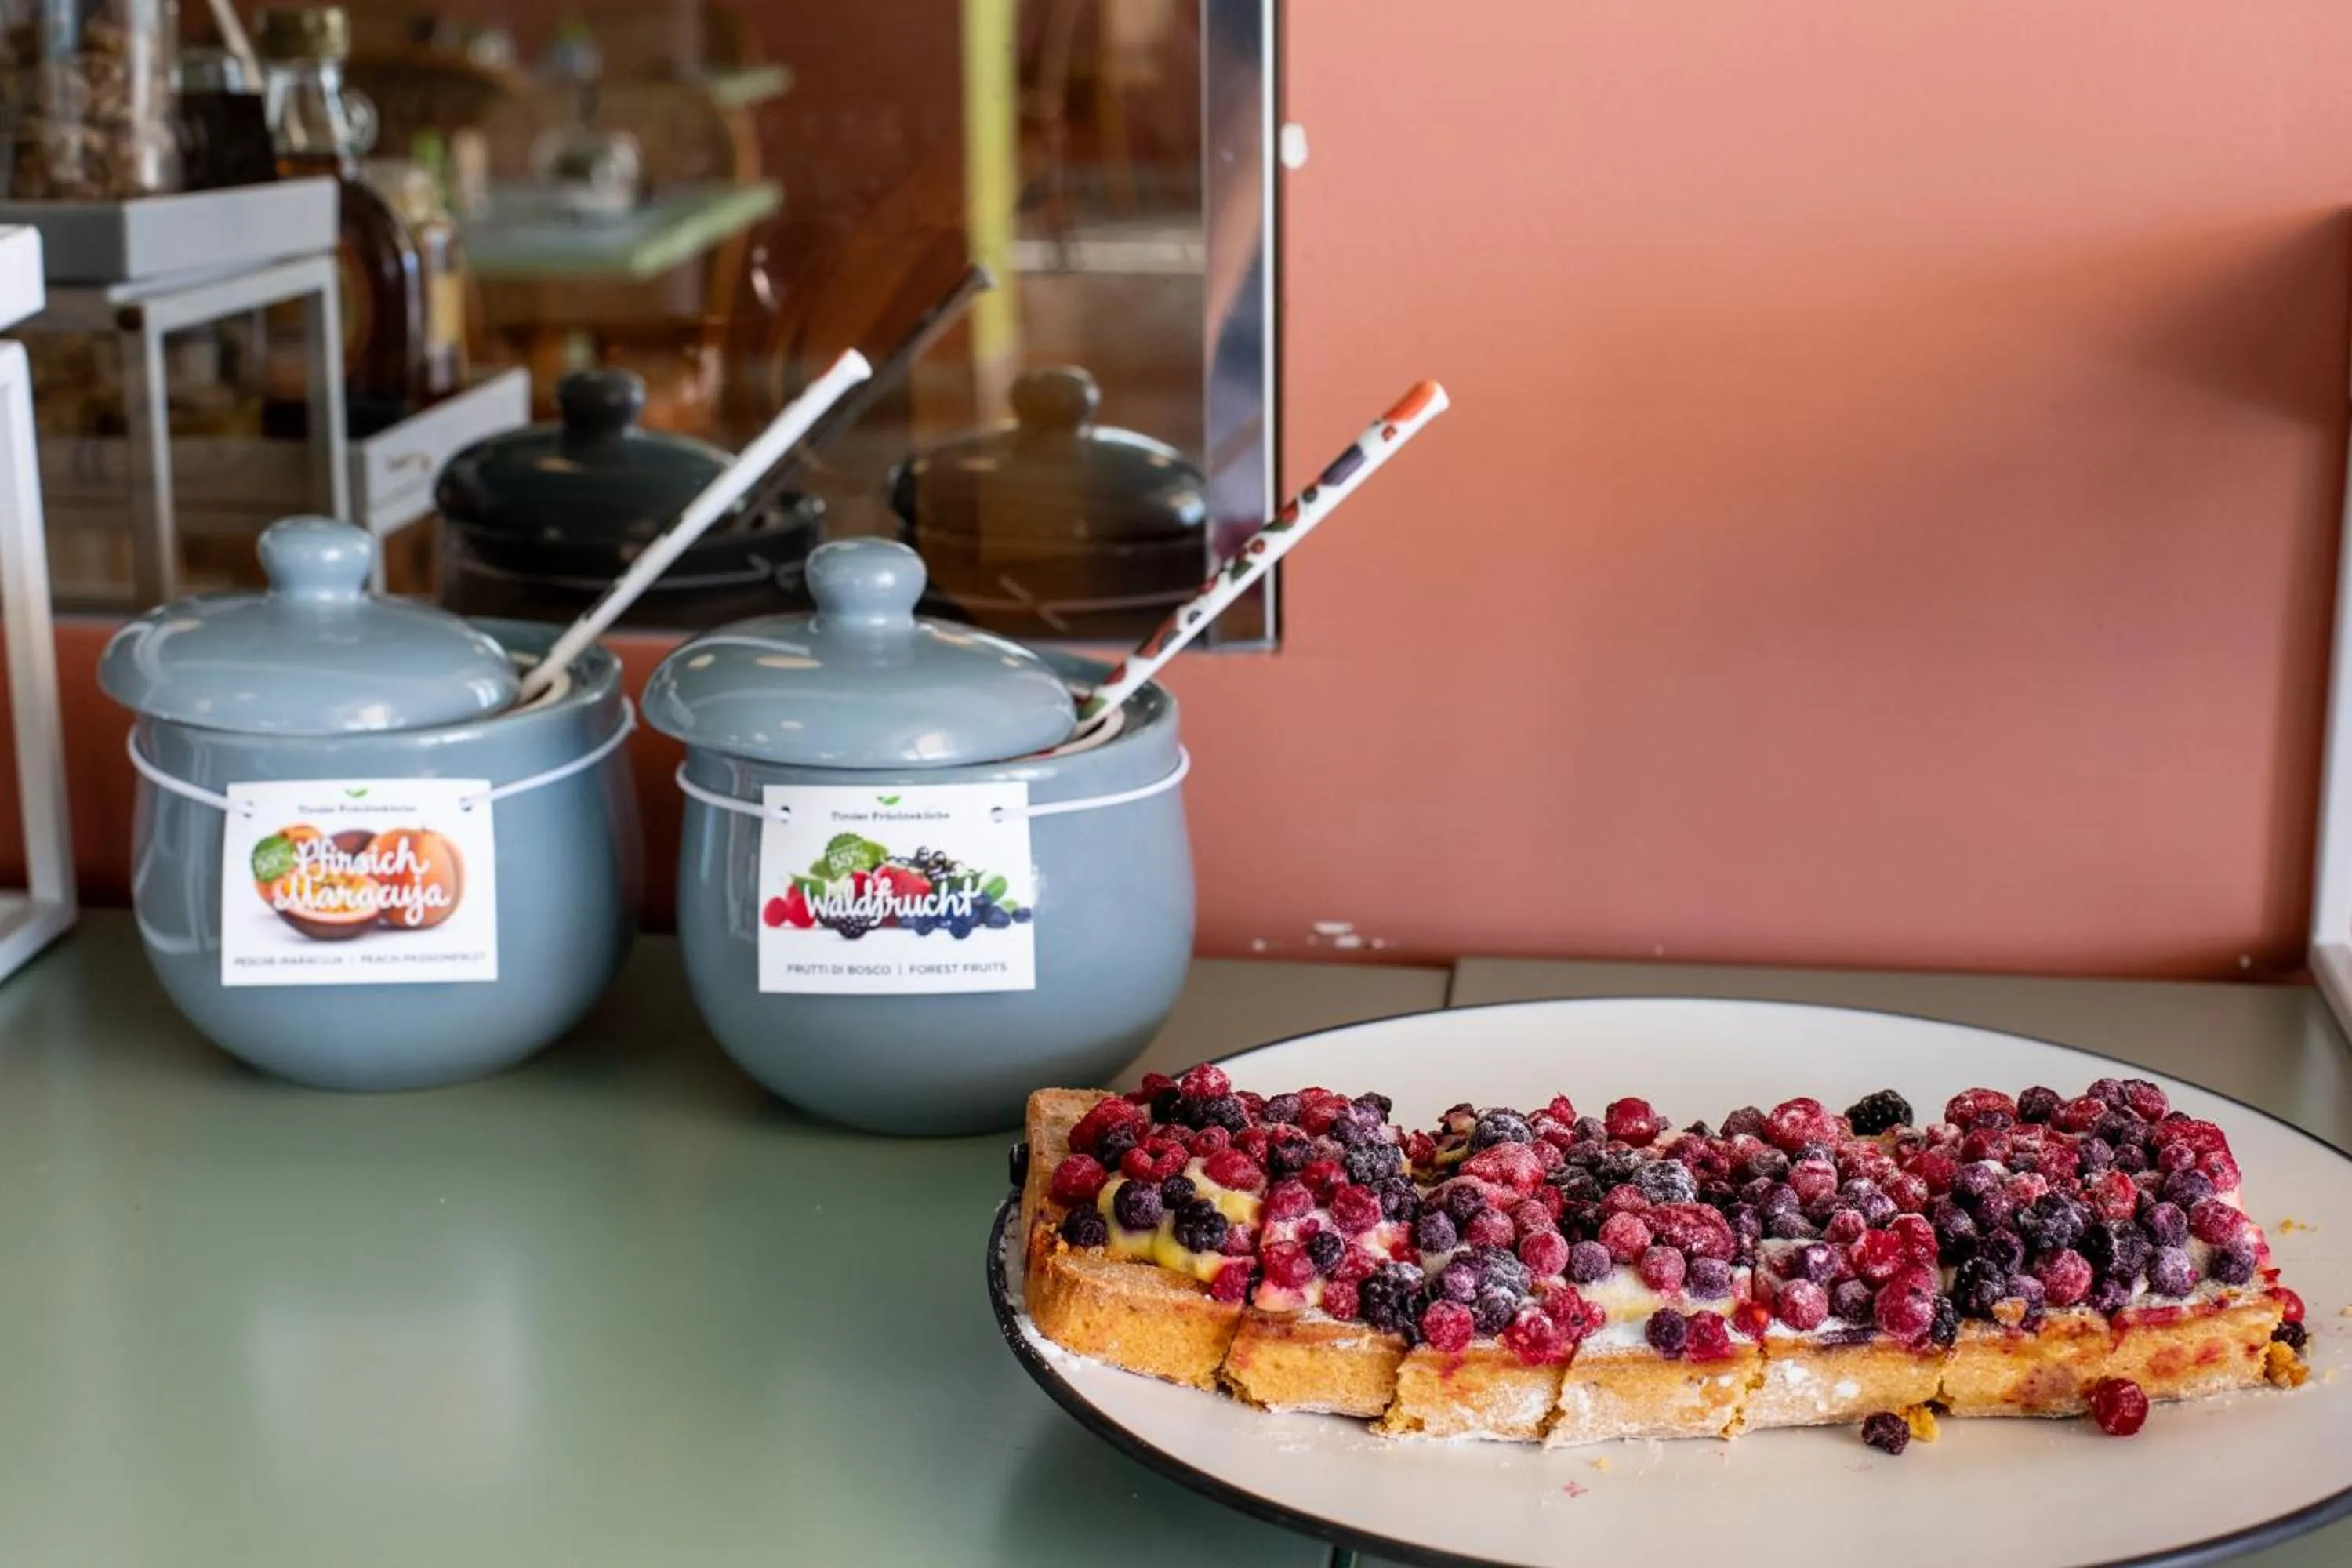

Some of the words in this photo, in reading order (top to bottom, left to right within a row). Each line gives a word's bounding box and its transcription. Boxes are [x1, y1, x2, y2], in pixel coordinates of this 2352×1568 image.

[293, 837, 430, 880] Pfirsich
[274, 876, 450, 926] Maracuja
[804, 877, 980, 925] Waldfrucht
[787, 964, 828, 975] FRUTTI
[831, 964, 844, 975] DI
[848, 964, 891, 975] BOSCO
[909, 963, 958, 974] FOREST
[963, 962, 1007, 973] FRUITS
